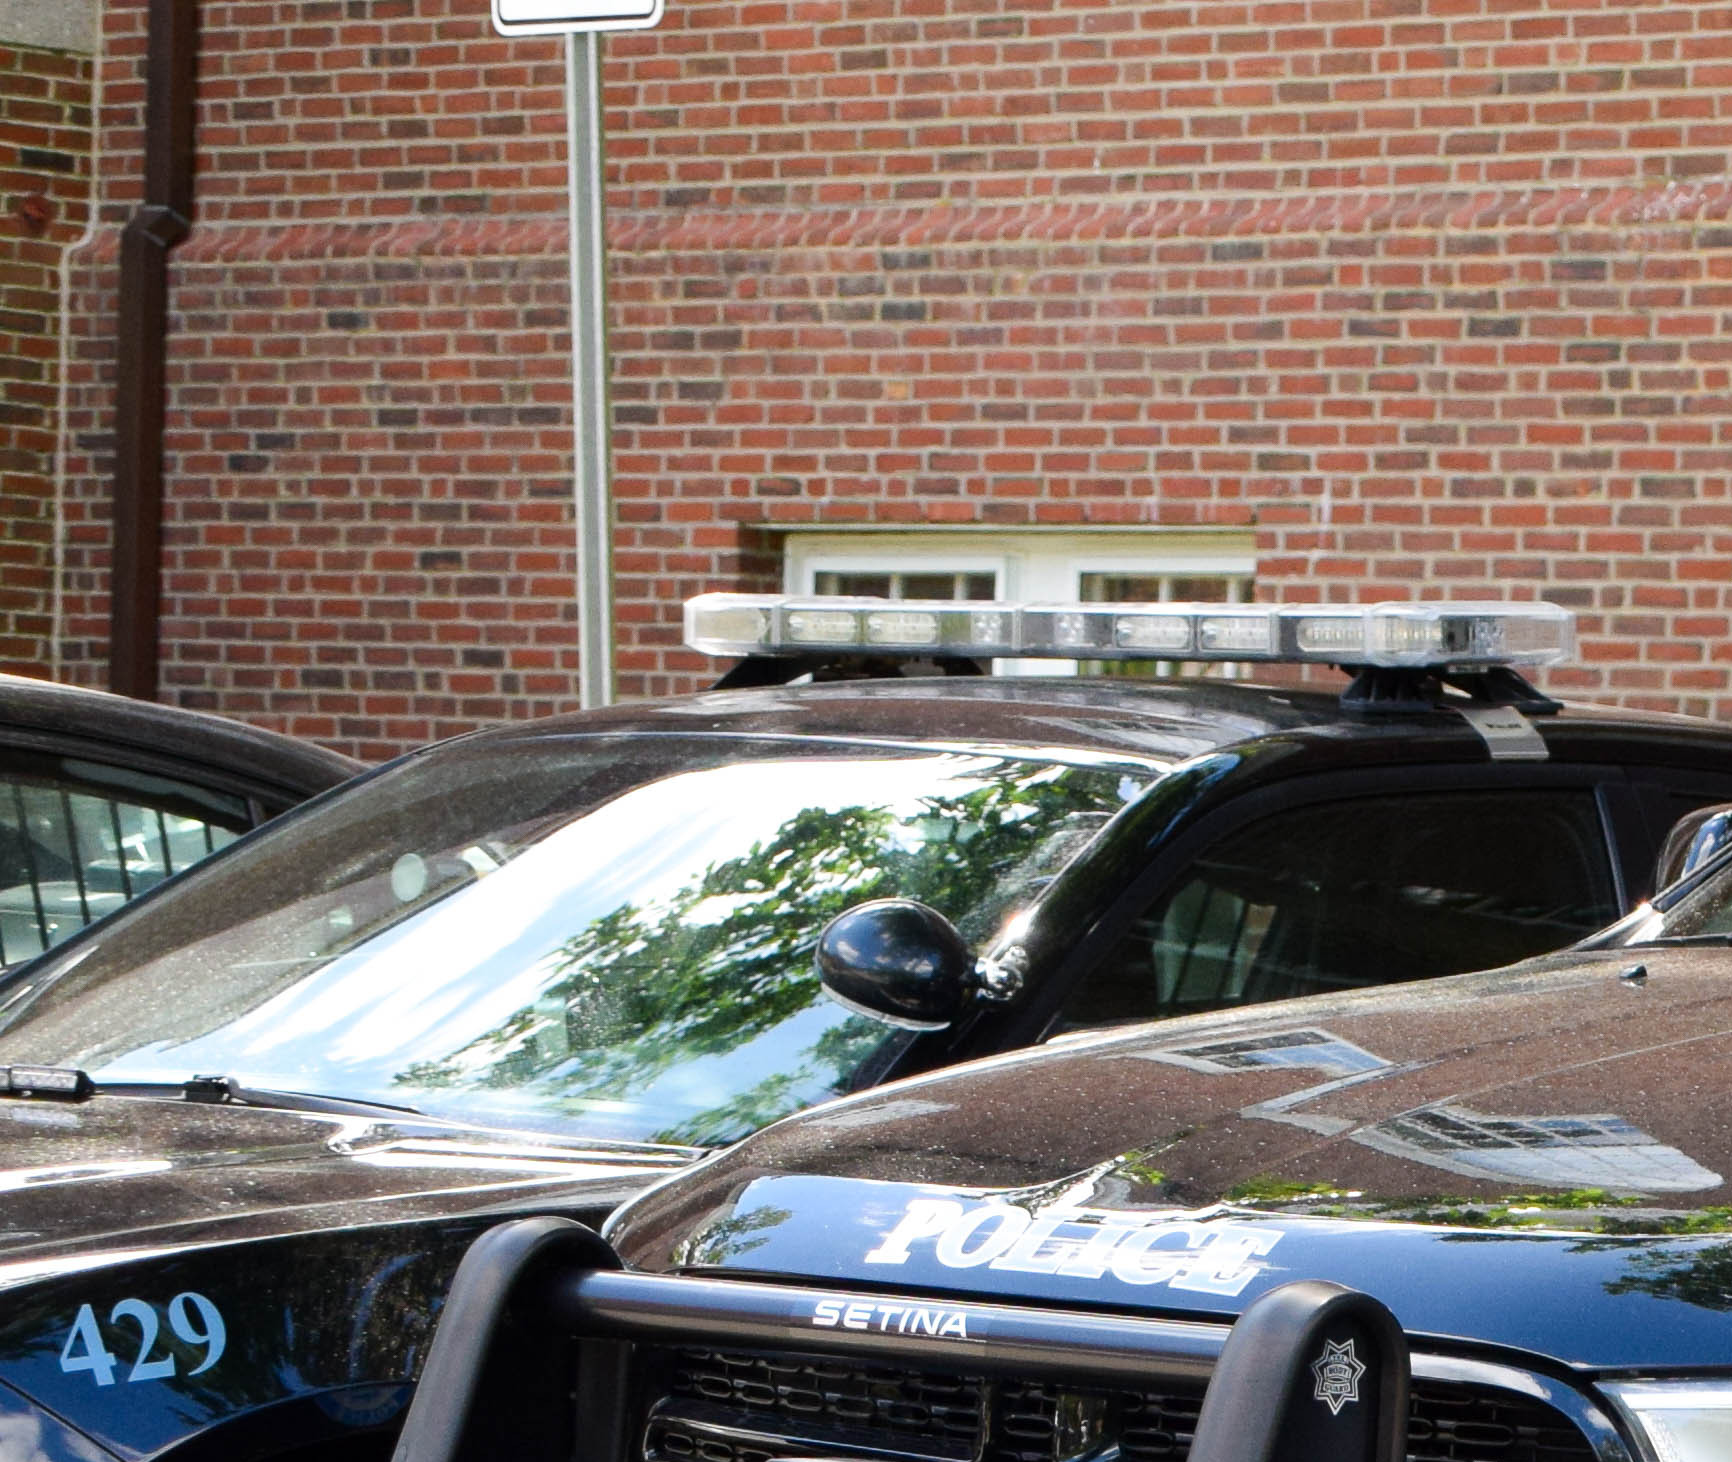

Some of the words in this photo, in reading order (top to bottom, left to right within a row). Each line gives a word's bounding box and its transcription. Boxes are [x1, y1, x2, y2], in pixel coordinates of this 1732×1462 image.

[864, 1199, 1286, 1297] POLICE
[60, 1291, 227, 1387] 429
[812, 1299, 968, 1339] SETINA
